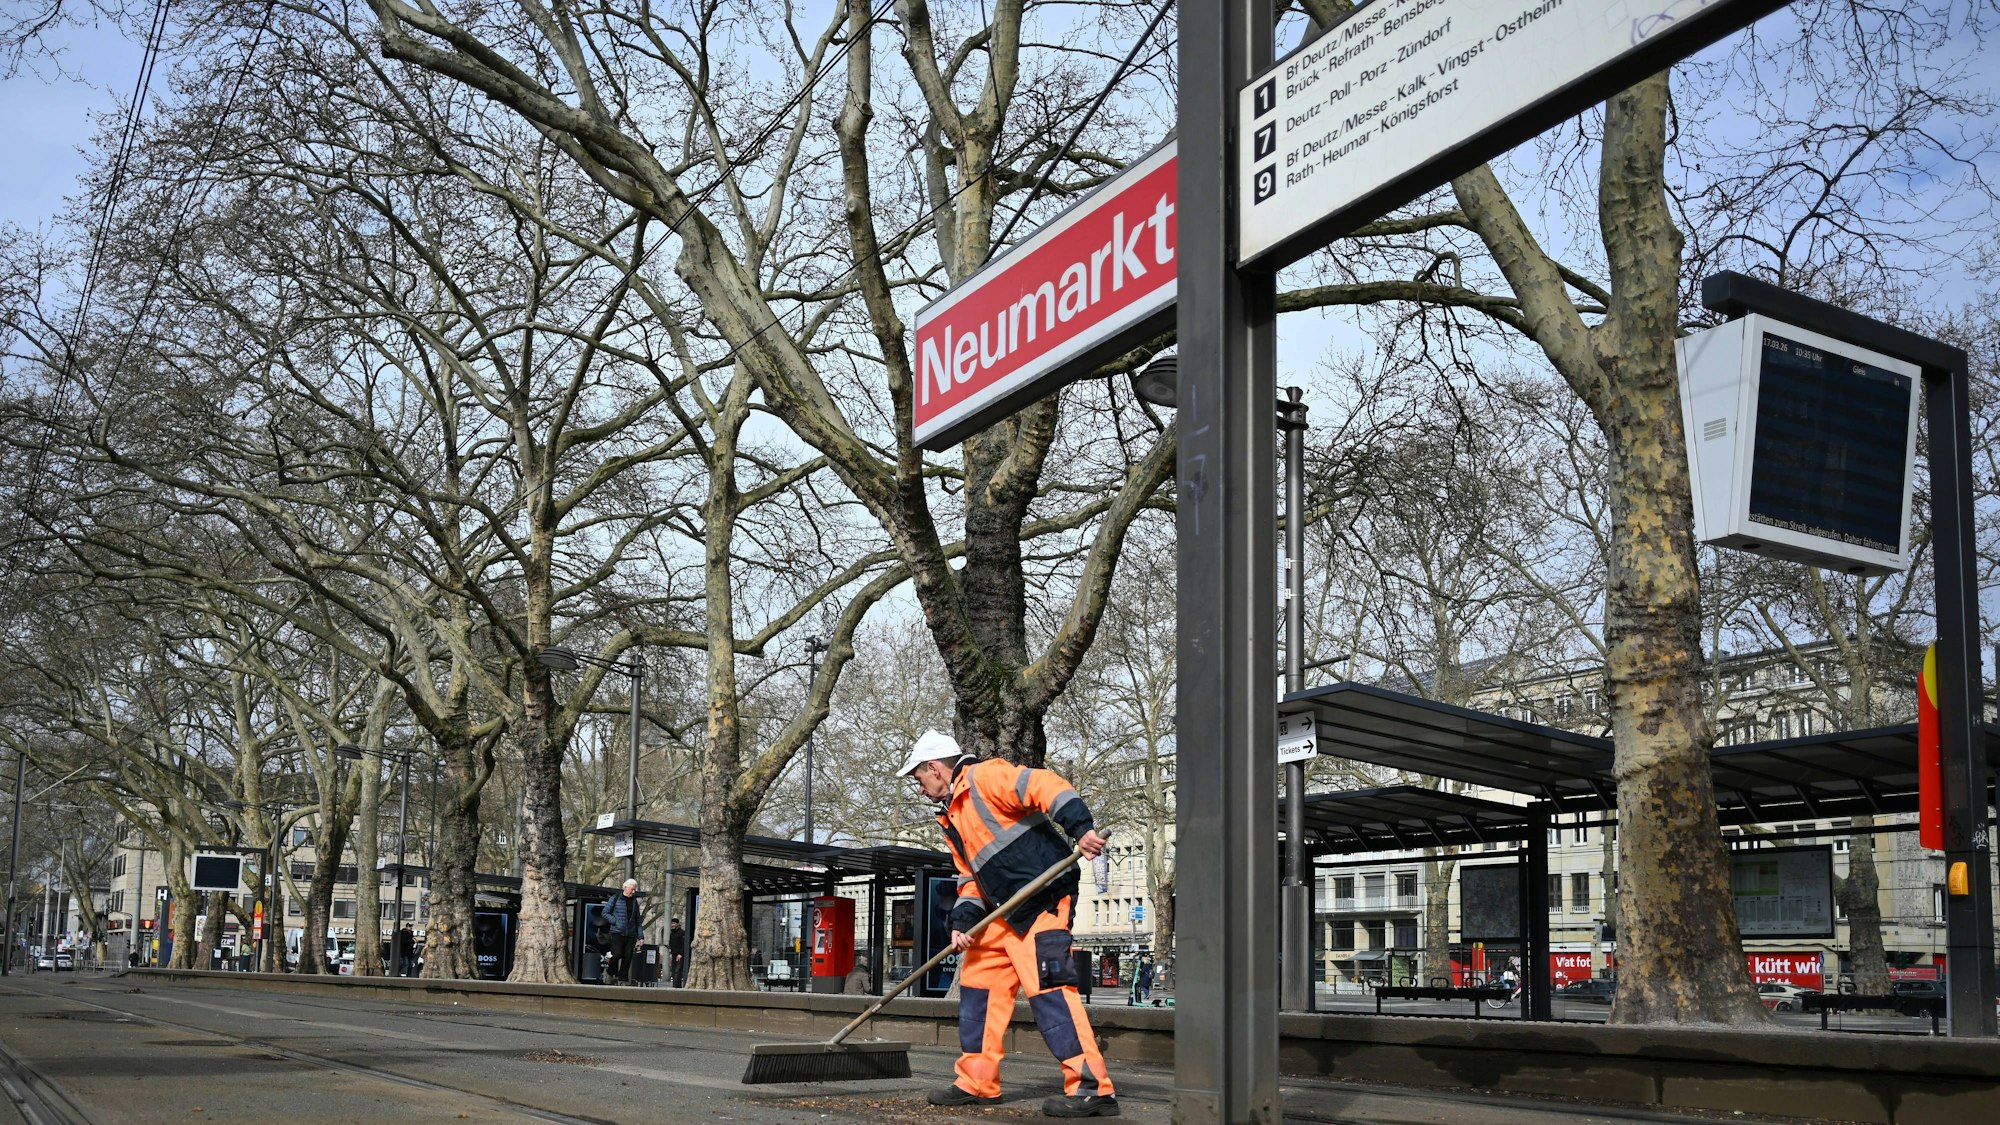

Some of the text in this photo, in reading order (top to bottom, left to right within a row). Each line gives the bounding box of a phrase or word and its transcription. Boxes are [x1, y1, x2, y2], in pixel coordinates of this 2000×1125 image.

[1286, 68, 1321, 100] Brück
[1329, 34, 1374, 73] Refrath
[1286, 62, 1300, 81] Bf
[1286, 104, 1321, 133] Deutz
[1330, 81, 1351, 105] Poll
[1360, 61, 1388, 87] Porz
[1397, 16, 1452, 64] Zündorf
[1259, 85, 1269, 110] 1
[1286, 148, 1301, 168] Bf
[1397, 74, 1427, 101] Kalk
[1437, 39, 1485, 76] Vingst
[1258, 128, 1272, 155] 7
[1286, 162, 1314, 188] Rath
[1322, 131, 1371, 167] Heumar
[1381, 77, 1459, 133] Königsforst
[1258, 171, 1272, 198] 9
[921, 193, 1175, 406] Neumarkt
[1774, 518, 1789, 529] zum
[1789, 520, 1808, 533] Streik
[1844, 533, 1863, 544] Daher
[1863, 537, 1883, 550] fahren
[1280, 746, 1301, 756] Tickets
[157, 889, 168, 900] H
[1754, 956, 1792, 974] kütt
